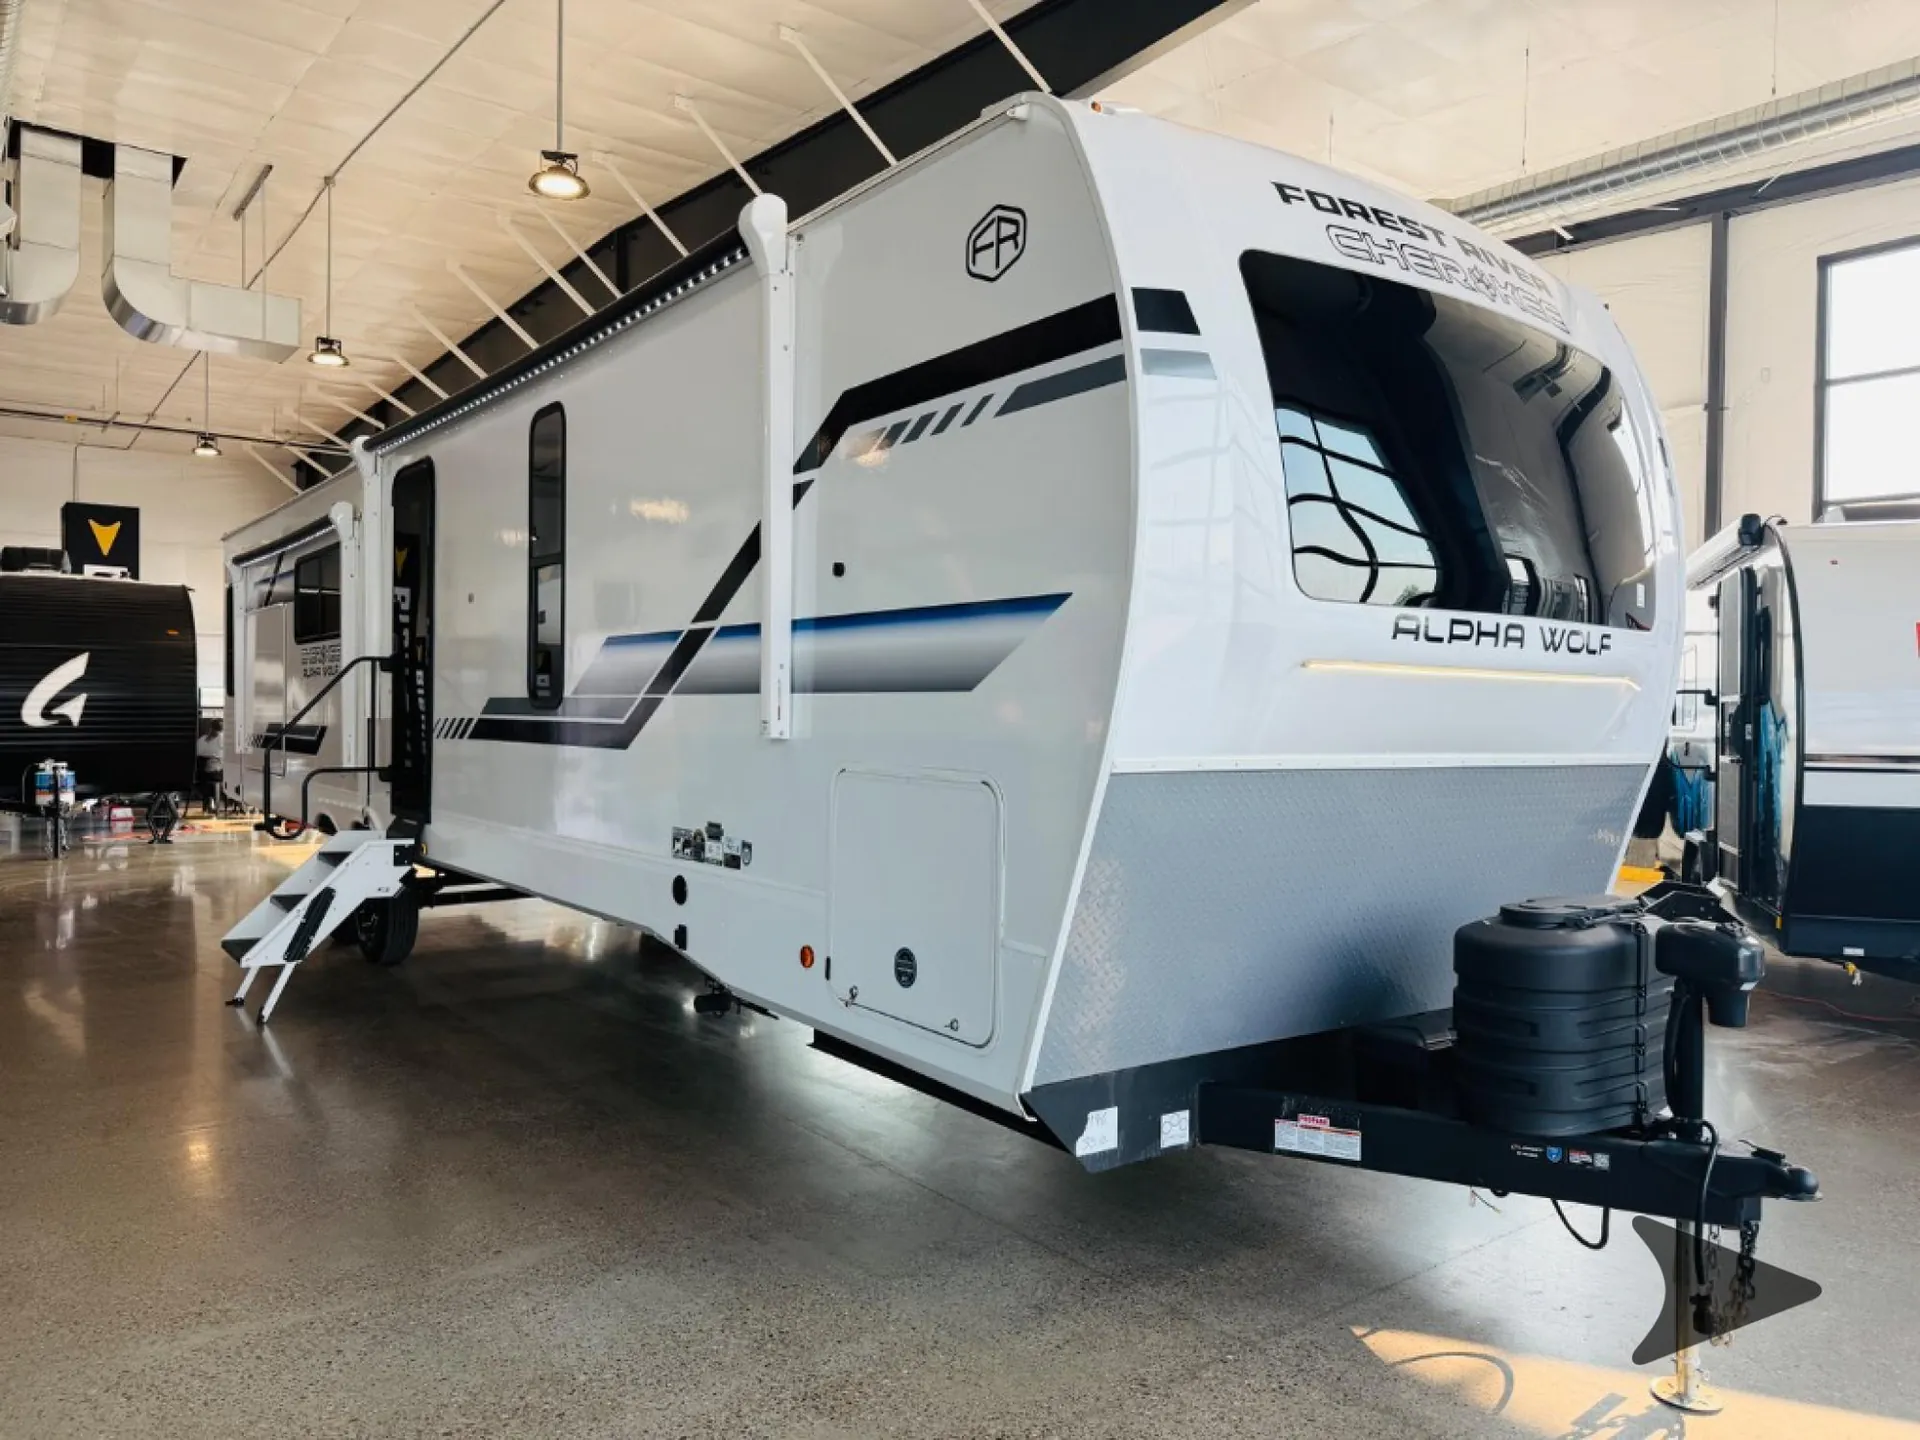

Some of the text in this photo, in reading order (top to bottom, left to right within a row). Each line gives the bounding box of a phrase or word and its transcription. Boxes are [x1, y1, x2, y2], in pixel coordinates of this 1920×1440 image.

[1269, 180, 1554, 299] FOREST RIVER
[1325, 223, 1571, 335] CHEROKEE
[1391, 613, 1613, 656] ALPHA WOLF
